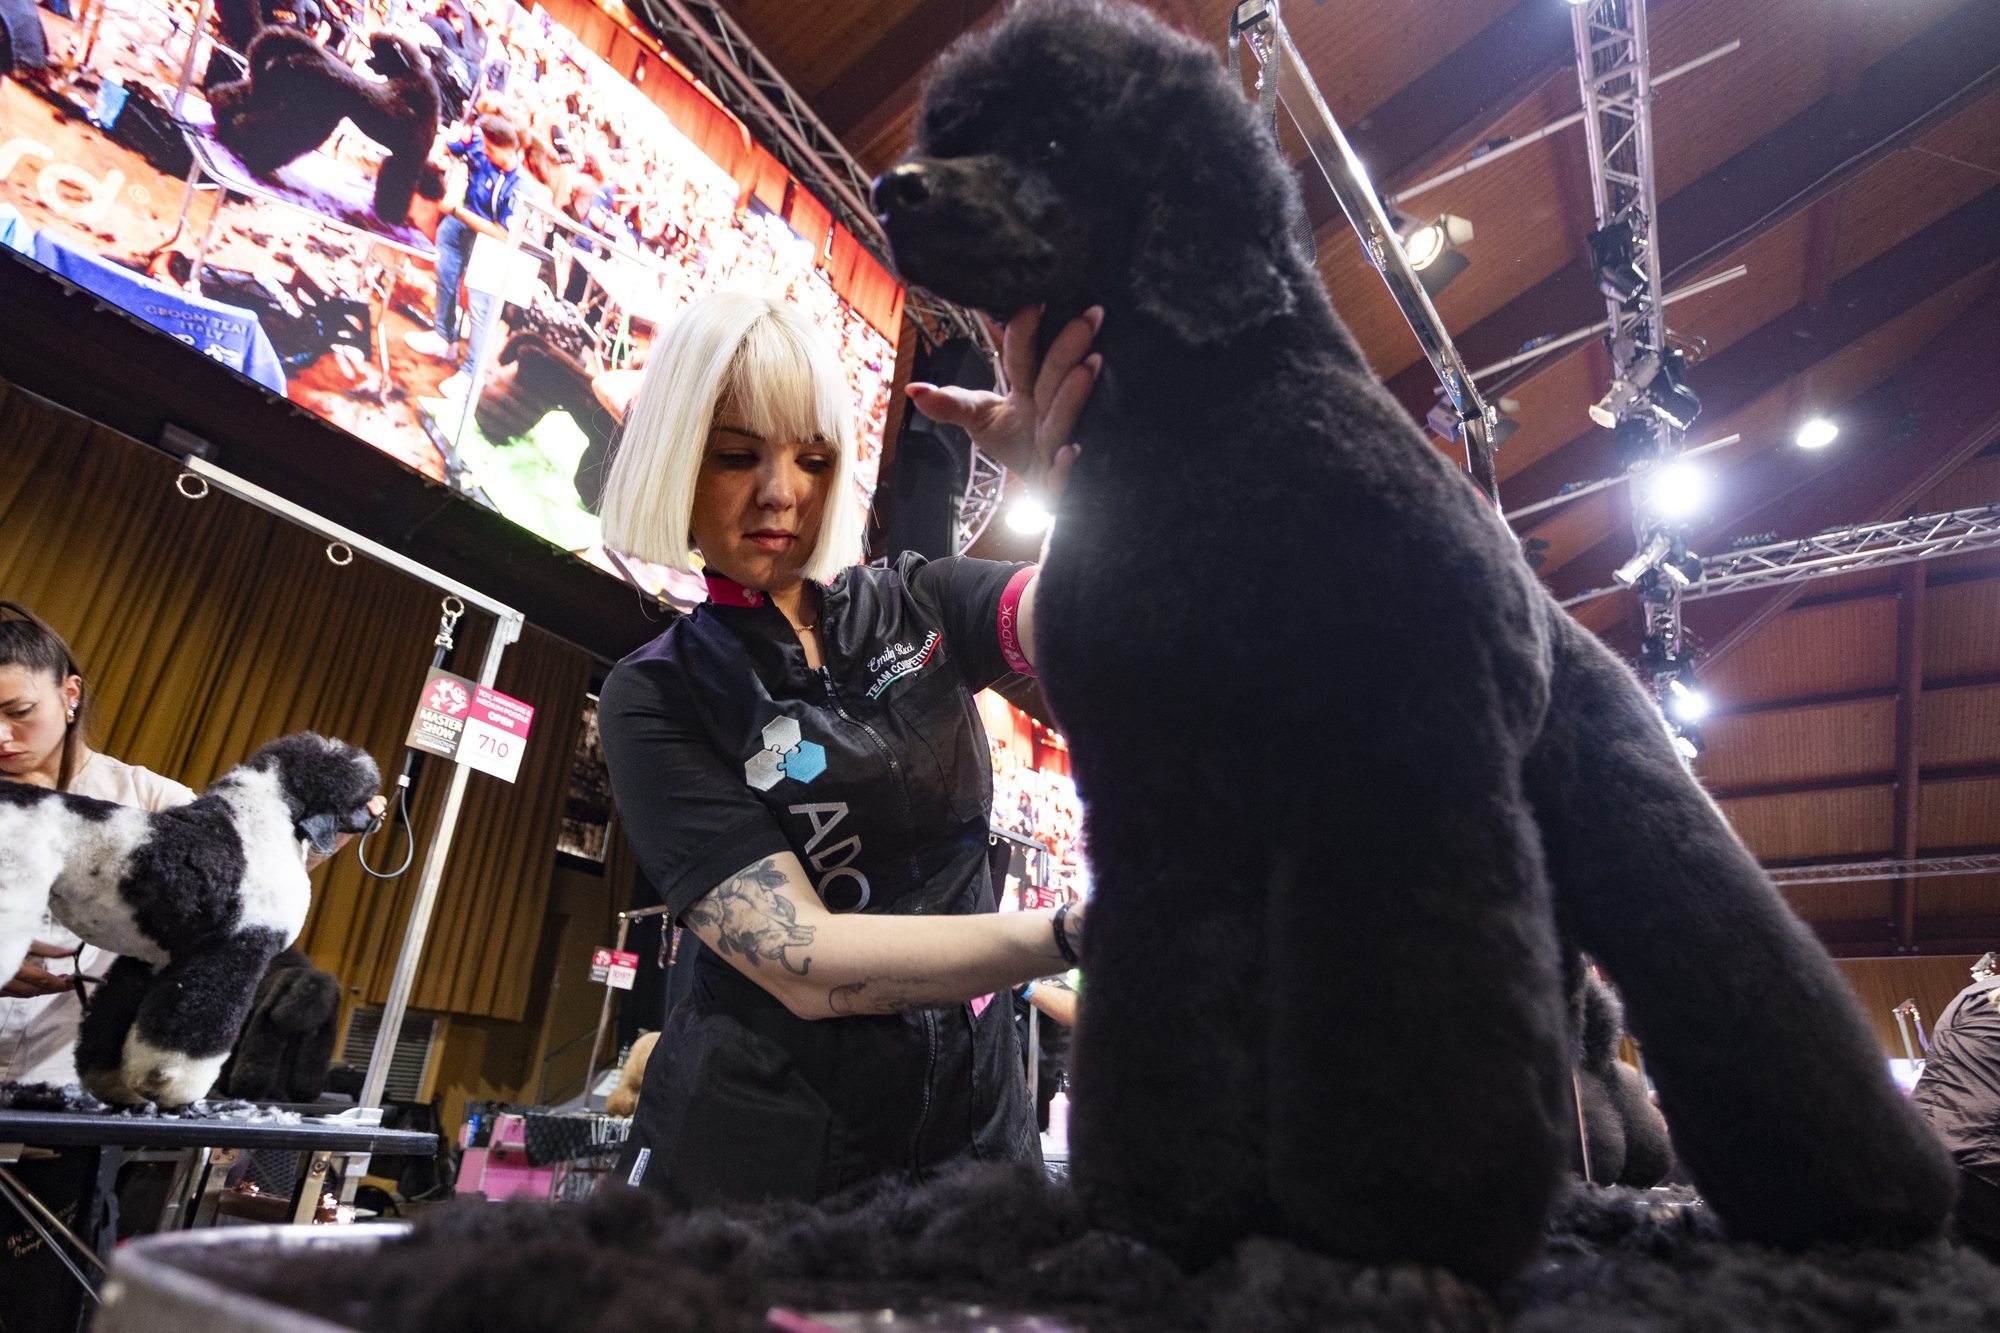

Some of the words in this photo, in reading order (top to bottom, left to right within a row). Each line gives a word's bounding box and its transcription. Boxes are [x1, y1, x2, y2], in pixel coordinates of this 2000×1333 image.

[180, 320, 224, 340] ITALY
[1001, 604, 1013, 649] ADOK
[866, 670, 893, 697] TEAM
[890, 630, 938, 674] COMPETITION
[867, 646, 897, 673] Emily
[419, 710, 464, 732] MASTER
[421, 721, 456, 740] SHOW
[478, 733, 509, 758] 710
